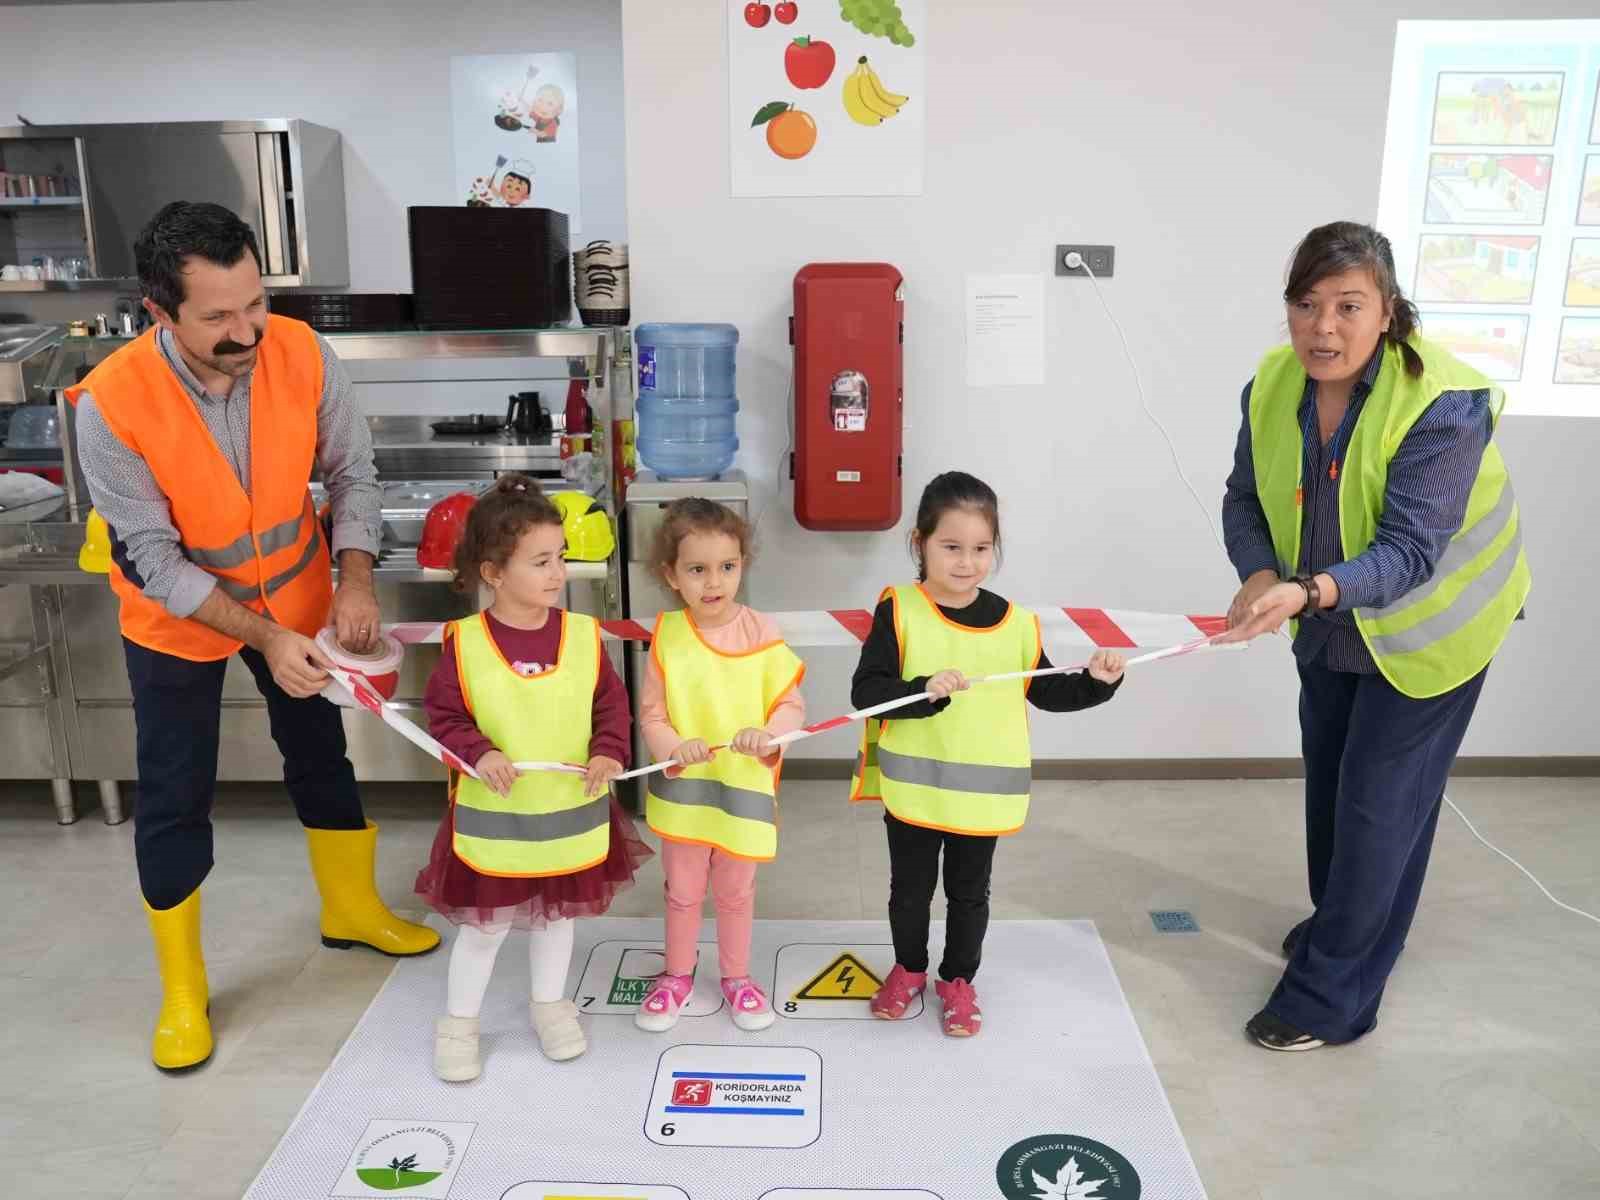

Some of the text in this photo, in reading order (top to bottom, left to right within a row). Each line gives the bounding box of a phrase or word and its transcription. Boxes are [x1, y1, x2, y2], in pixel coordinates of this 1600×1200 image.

[616, 979, 637, 991] İLK
[581, 996, 596, 1008] 7
[784, 1001, 798, 1013] 8
[715, 1081, 802, 1092] KORİDORLARDA
[724, 1094, 792, 1104] KOŞMAYINIZ
[660, 1122, 676, 1137] 6
